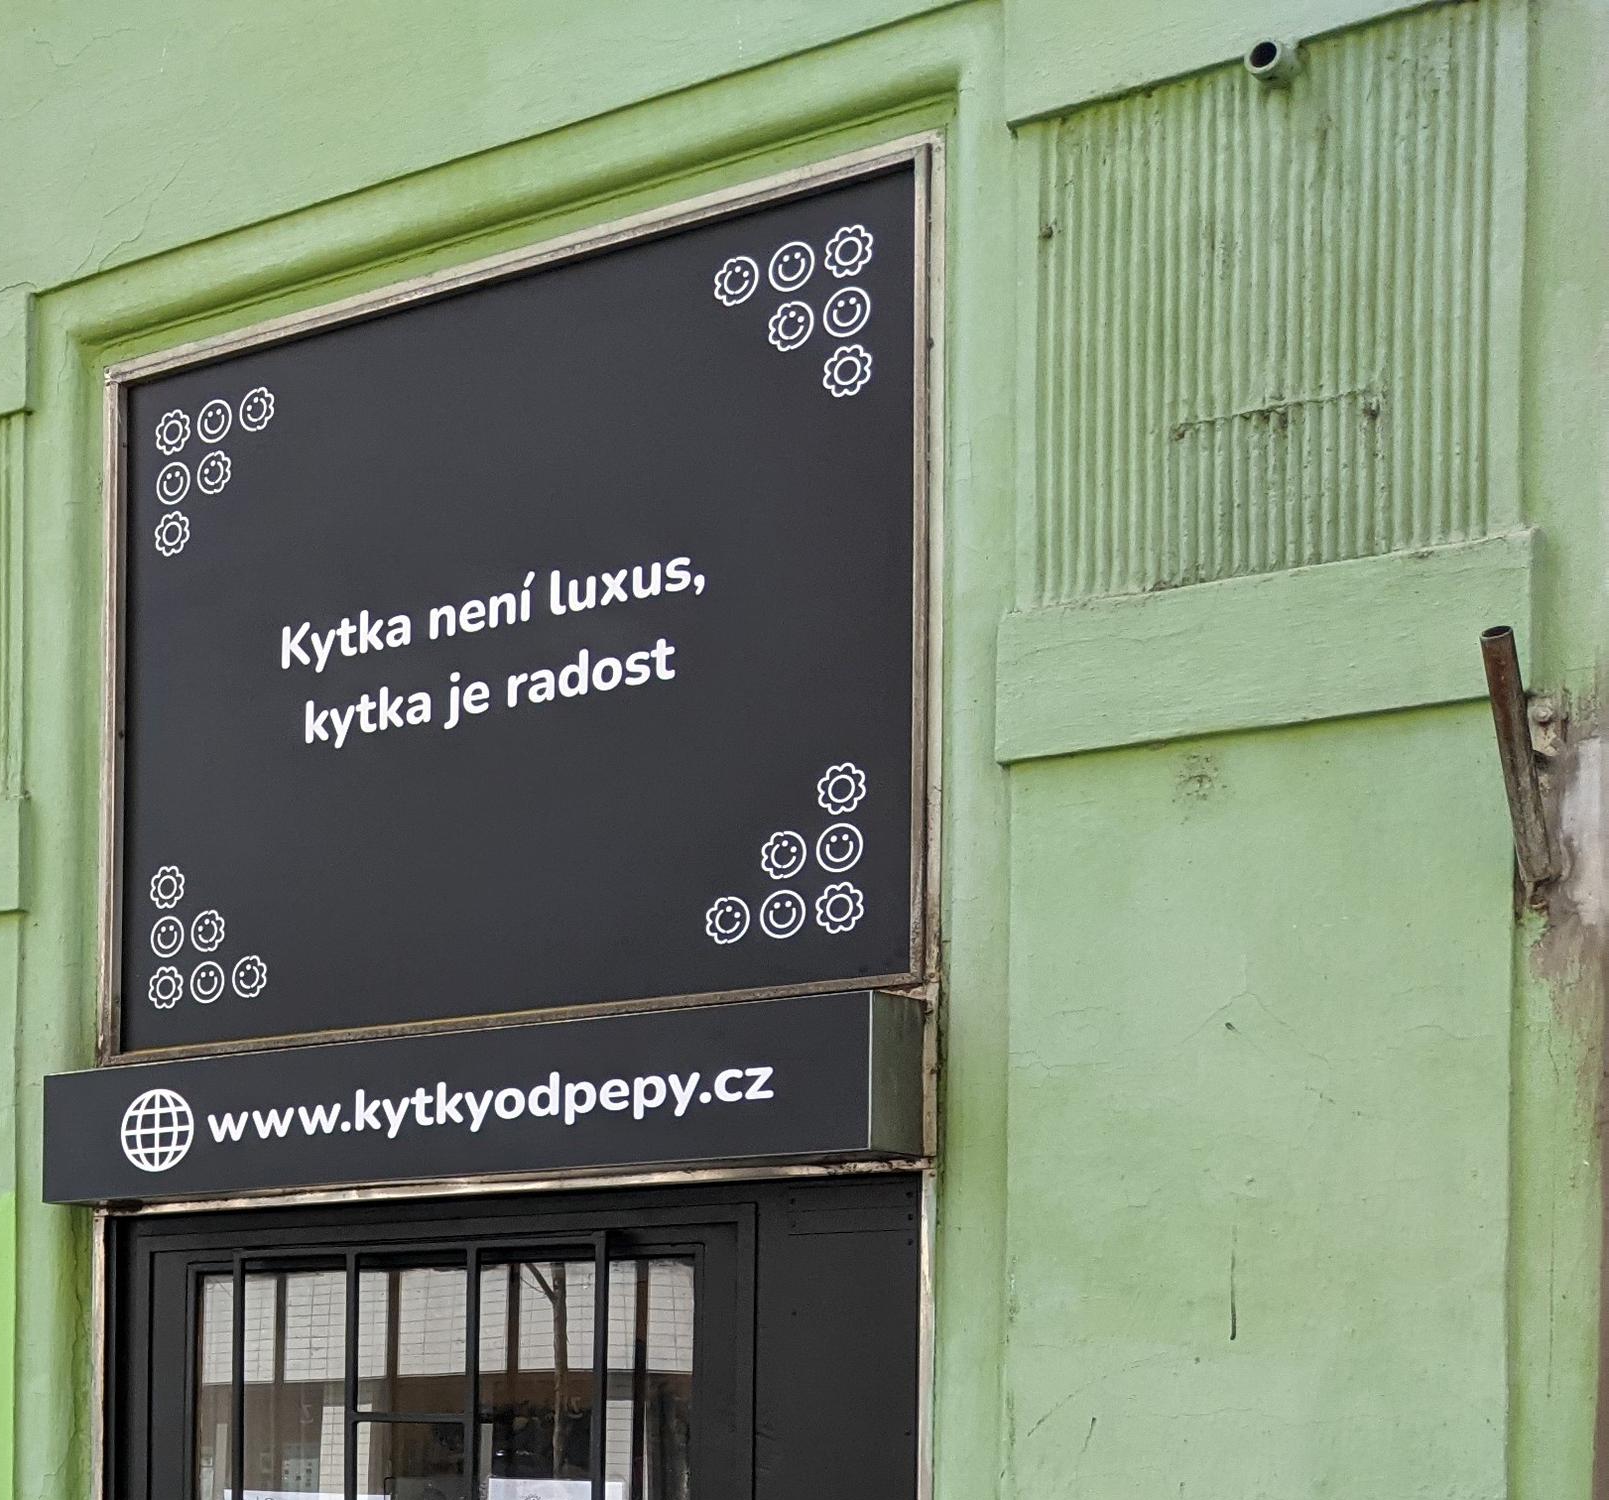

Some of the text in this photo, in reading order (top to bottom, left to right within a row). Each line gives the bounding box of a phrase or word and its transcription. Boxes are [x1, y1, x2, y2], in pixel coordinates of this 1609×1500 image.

[280, 554, 707, 674] Kytka není luxus,
[304, 637, 677, 750] kytka je radost
[207, 1065, 775, 1143] www.kytkyodpepy.cz
